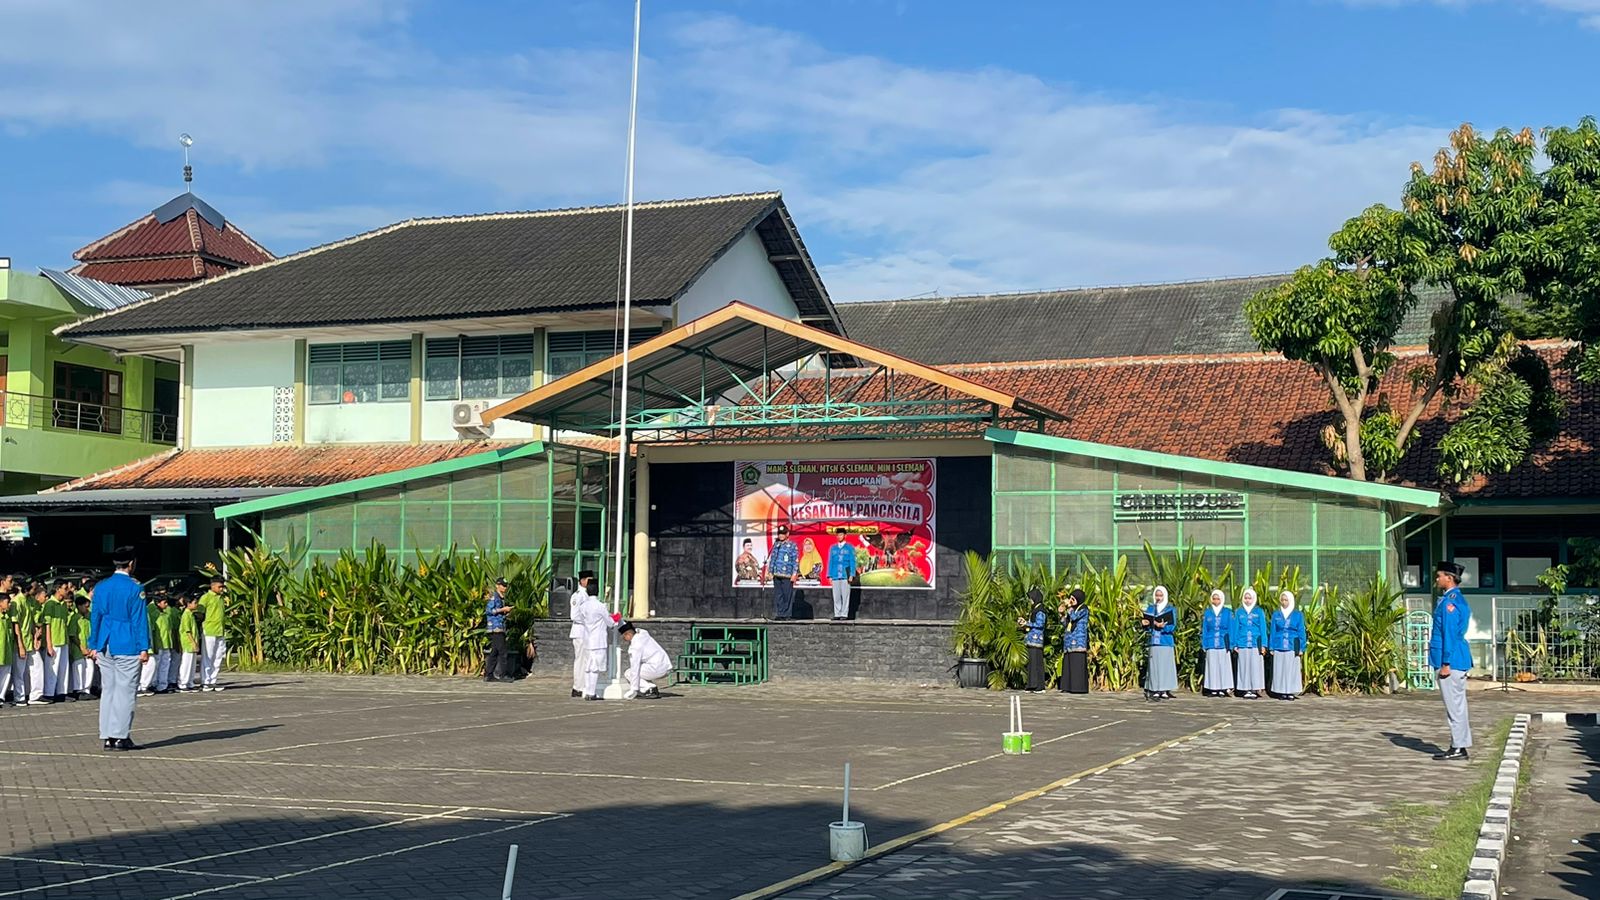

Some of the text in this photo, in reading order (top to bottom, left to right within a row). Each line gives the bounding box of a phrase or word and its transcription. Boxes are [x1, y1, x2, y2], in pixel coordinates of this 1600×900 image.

[767, 464, 782, 473] MAN
[839, 464, 845, 472] 6
[878, 464, 891, 472] MIN
[897, 464, 924, 472] SLEMAN
[821, 477, 881, 486] MENGUCAPKAN
[1121, 494, 1240, 509] GREEN HOUSE
[792, 503, 920, 521] KESAKTIAN PANCASILA
